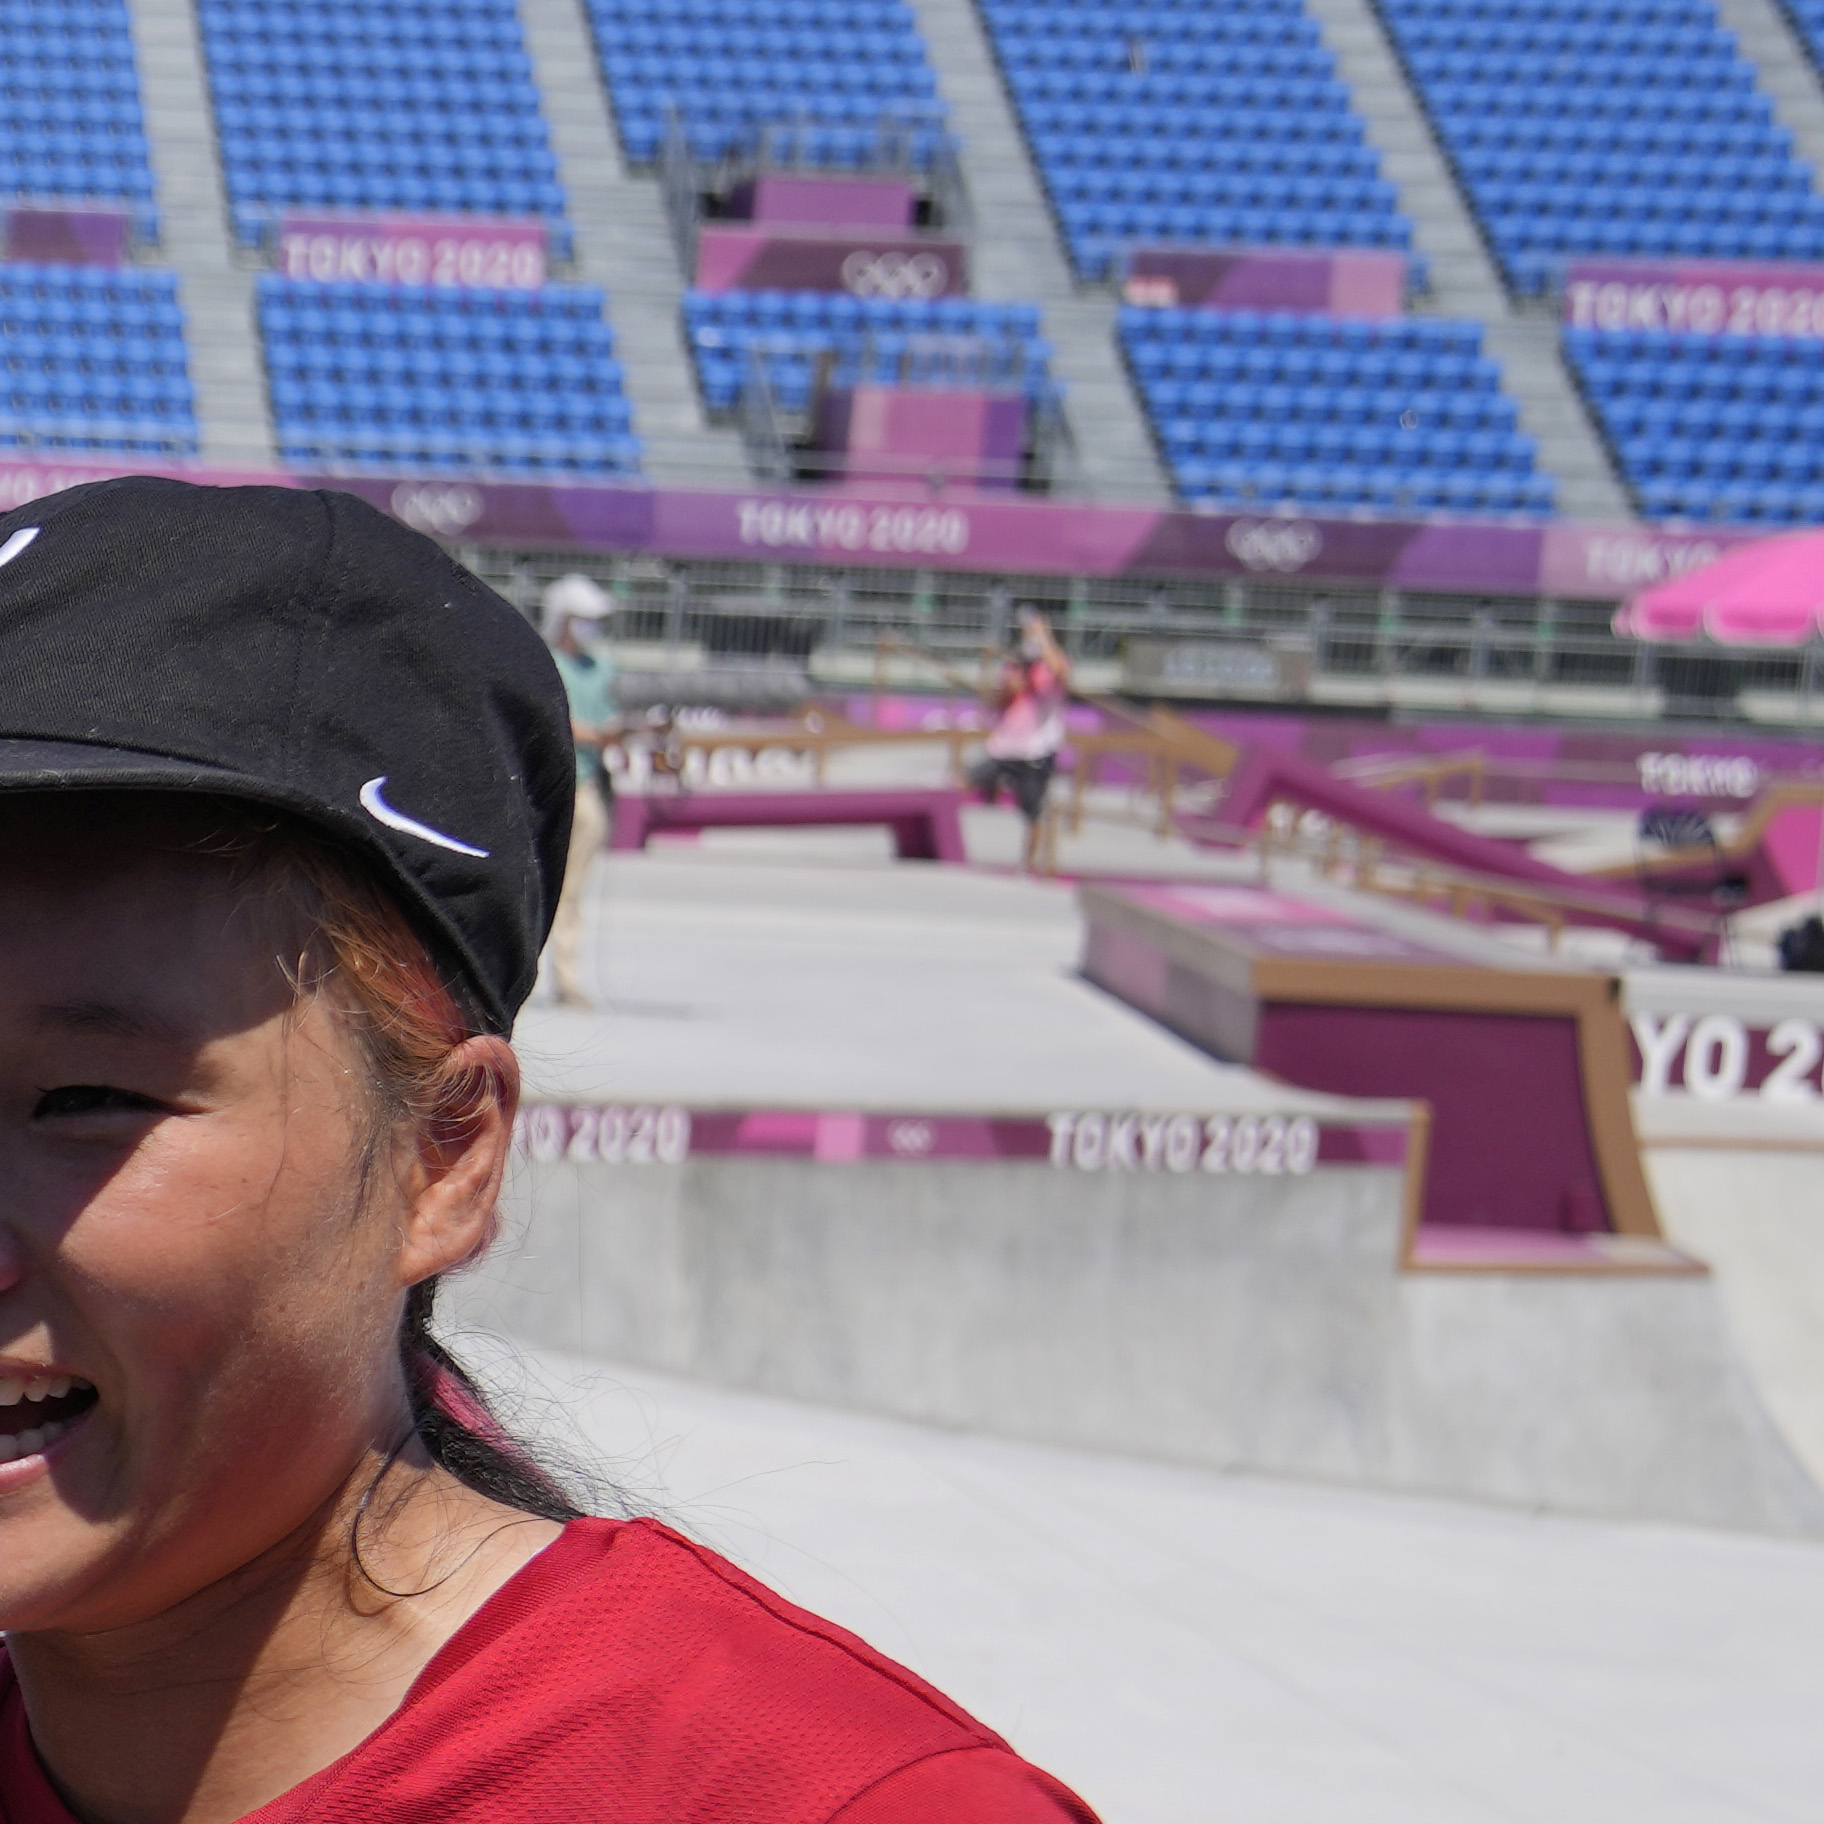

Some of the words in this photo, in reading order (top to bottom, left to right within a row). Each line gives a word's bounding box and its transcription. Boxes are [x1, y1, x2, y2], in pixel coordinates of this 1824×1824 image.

[281, 233, 428, 286] TOKYO
[432, 238, 544, 290] 2020
[1567, 281, 1724, 334] TOKYO
[738, 501, 867, 550] TOKYO
[869, 506, 970, 554] 2020
[568, 1106, 692, 1164] 2020
[1046, 1109, 1201, 1173] TOKYO
[1202, 1112, 1319, 1176] 2020
